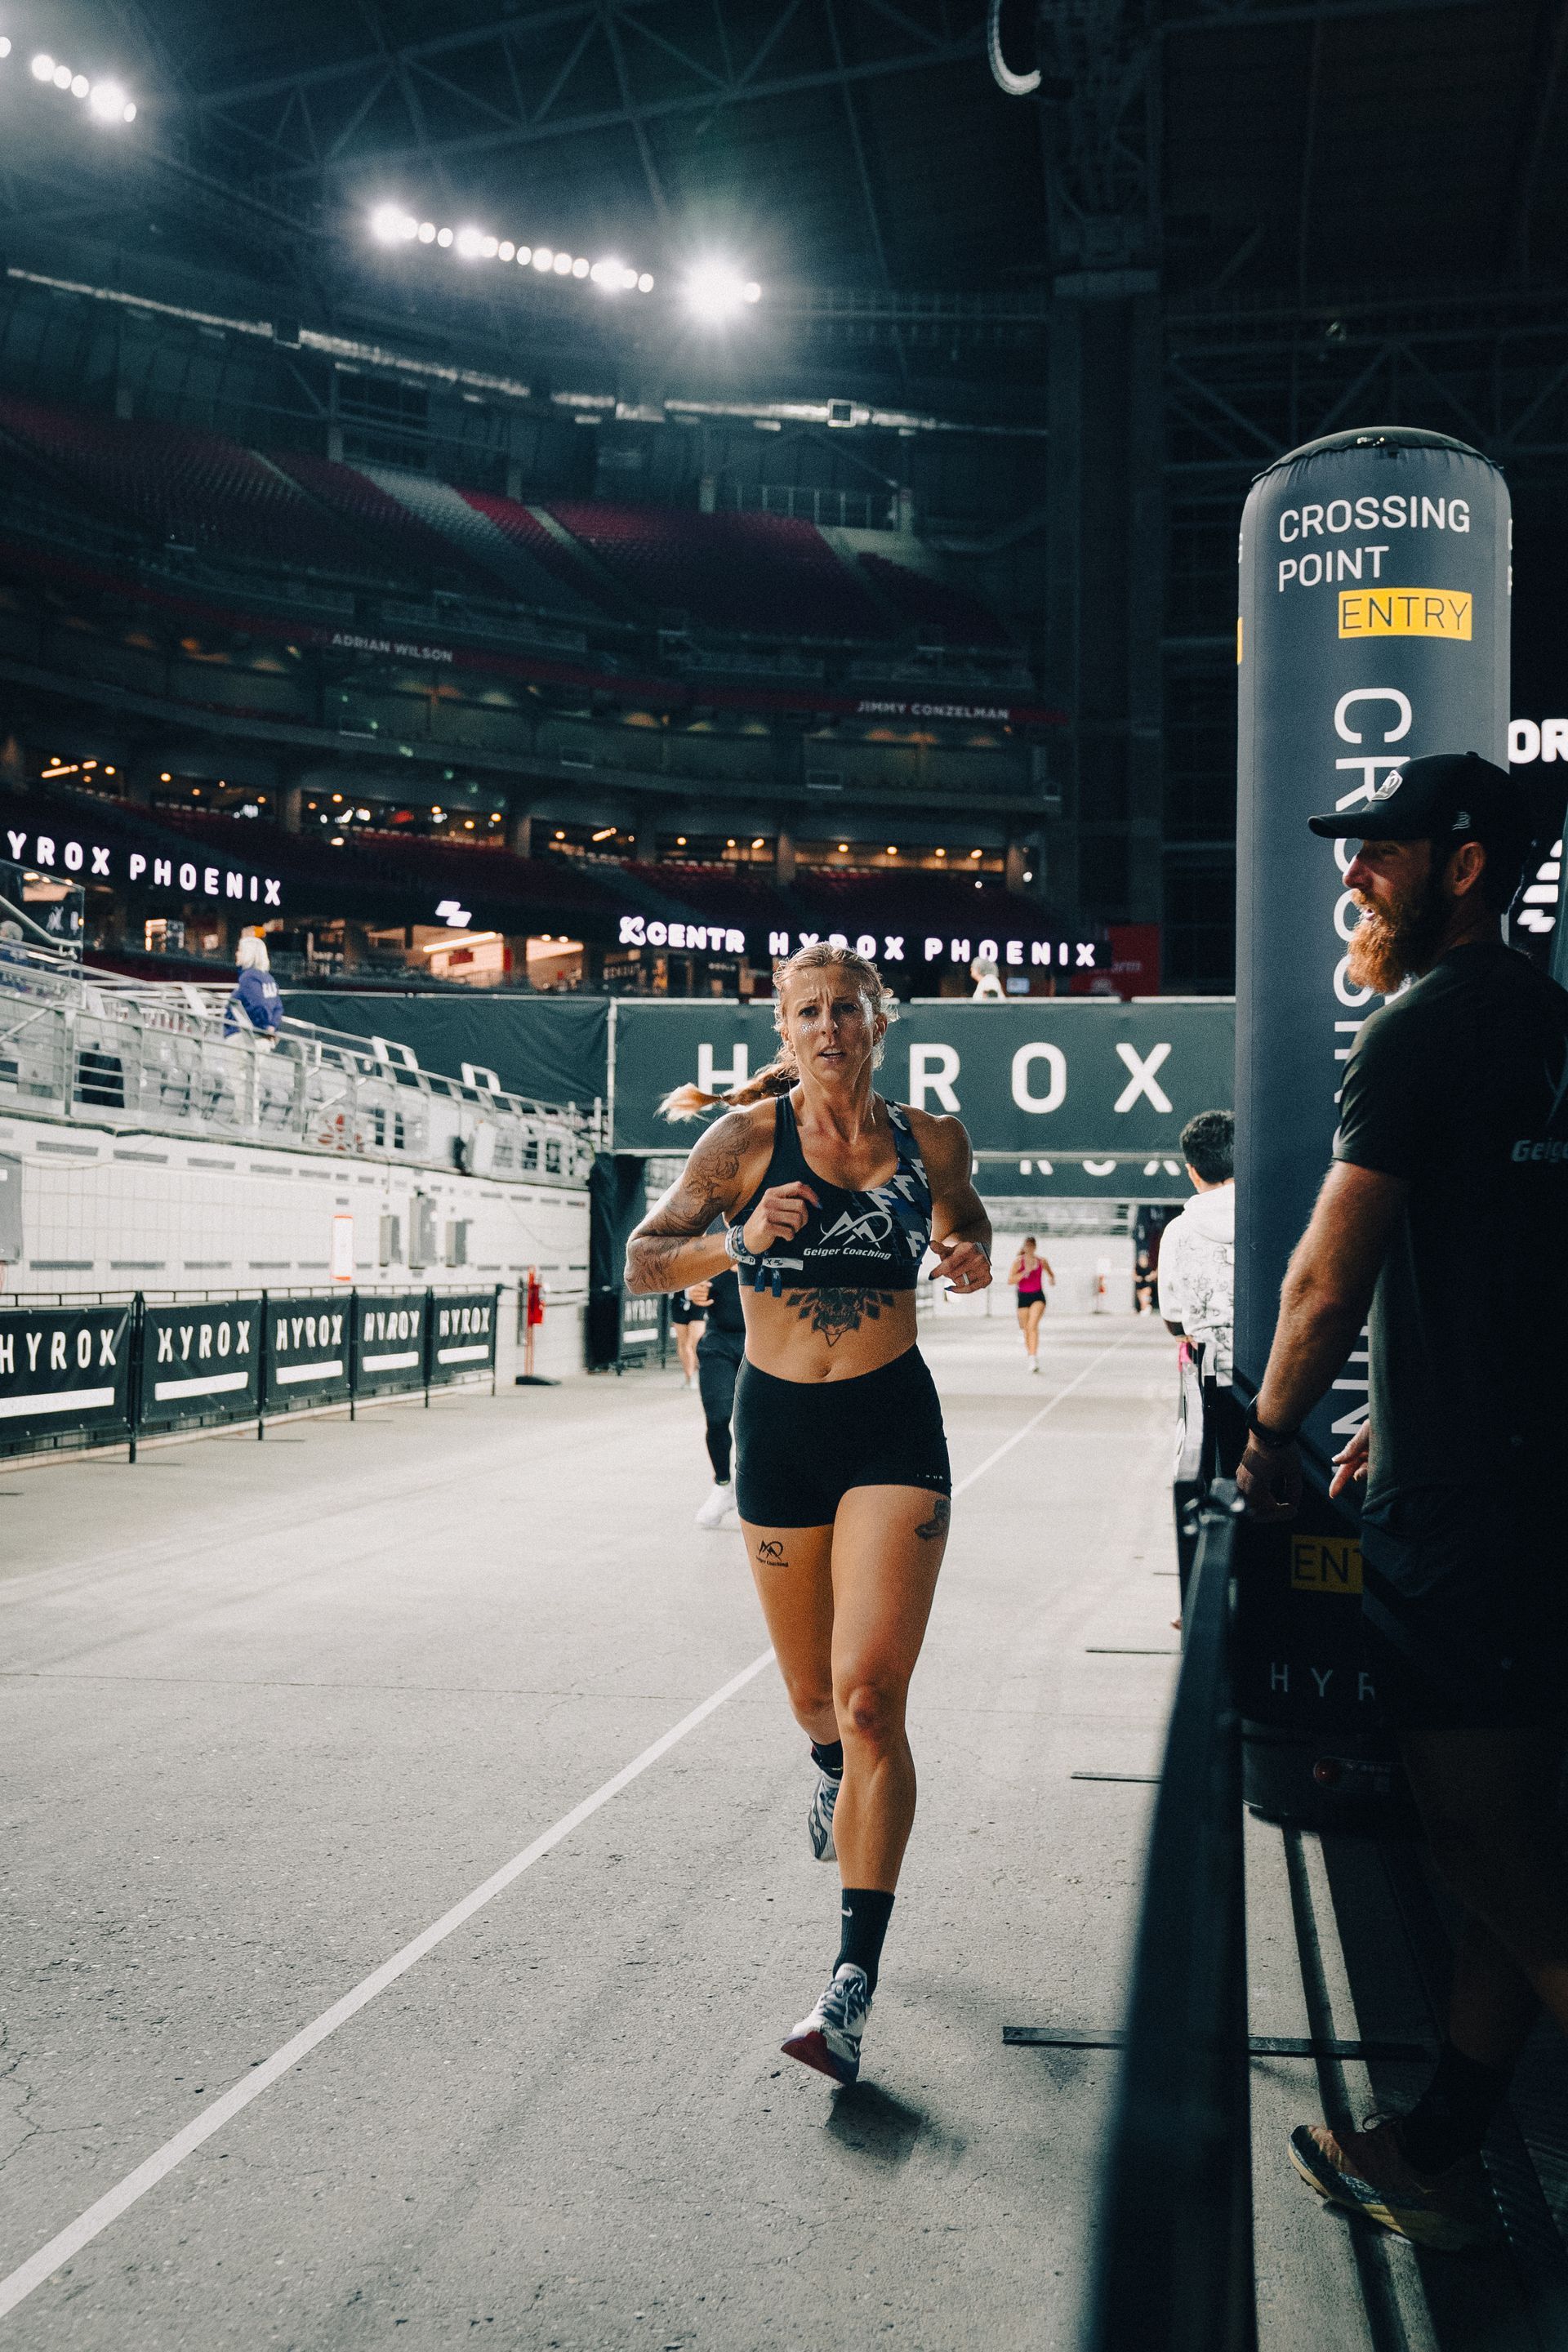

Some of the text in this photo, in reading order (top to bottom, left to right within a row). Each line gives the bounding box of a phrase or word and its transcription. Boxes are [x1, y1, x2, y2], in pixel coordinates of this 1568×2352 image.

[1279, 495, 1470, 543] CROSSING
[1278, 546, 1390, 593] POINT
[1342, 596, 1469, 630] ENTRY
[332, 633, 391, 653] ADRIAN
[394, 643, 453, 662] WILSON
[858, 701, 1009, 720] JIMMY CONZELMAN
[7, 830, 281, 906] YROX PHOENIX
[924, 937, 1096, 967] PHOENIX
[697, 1042, 1174, 1113] HROX
[803, 1246, 893, 1261] Geiger Coaching
[0, 1329, 117, 1374] HYROX
[158, 1321, 251, 1363] HYROX
[276, 1314, 343, 1352] HYROX
